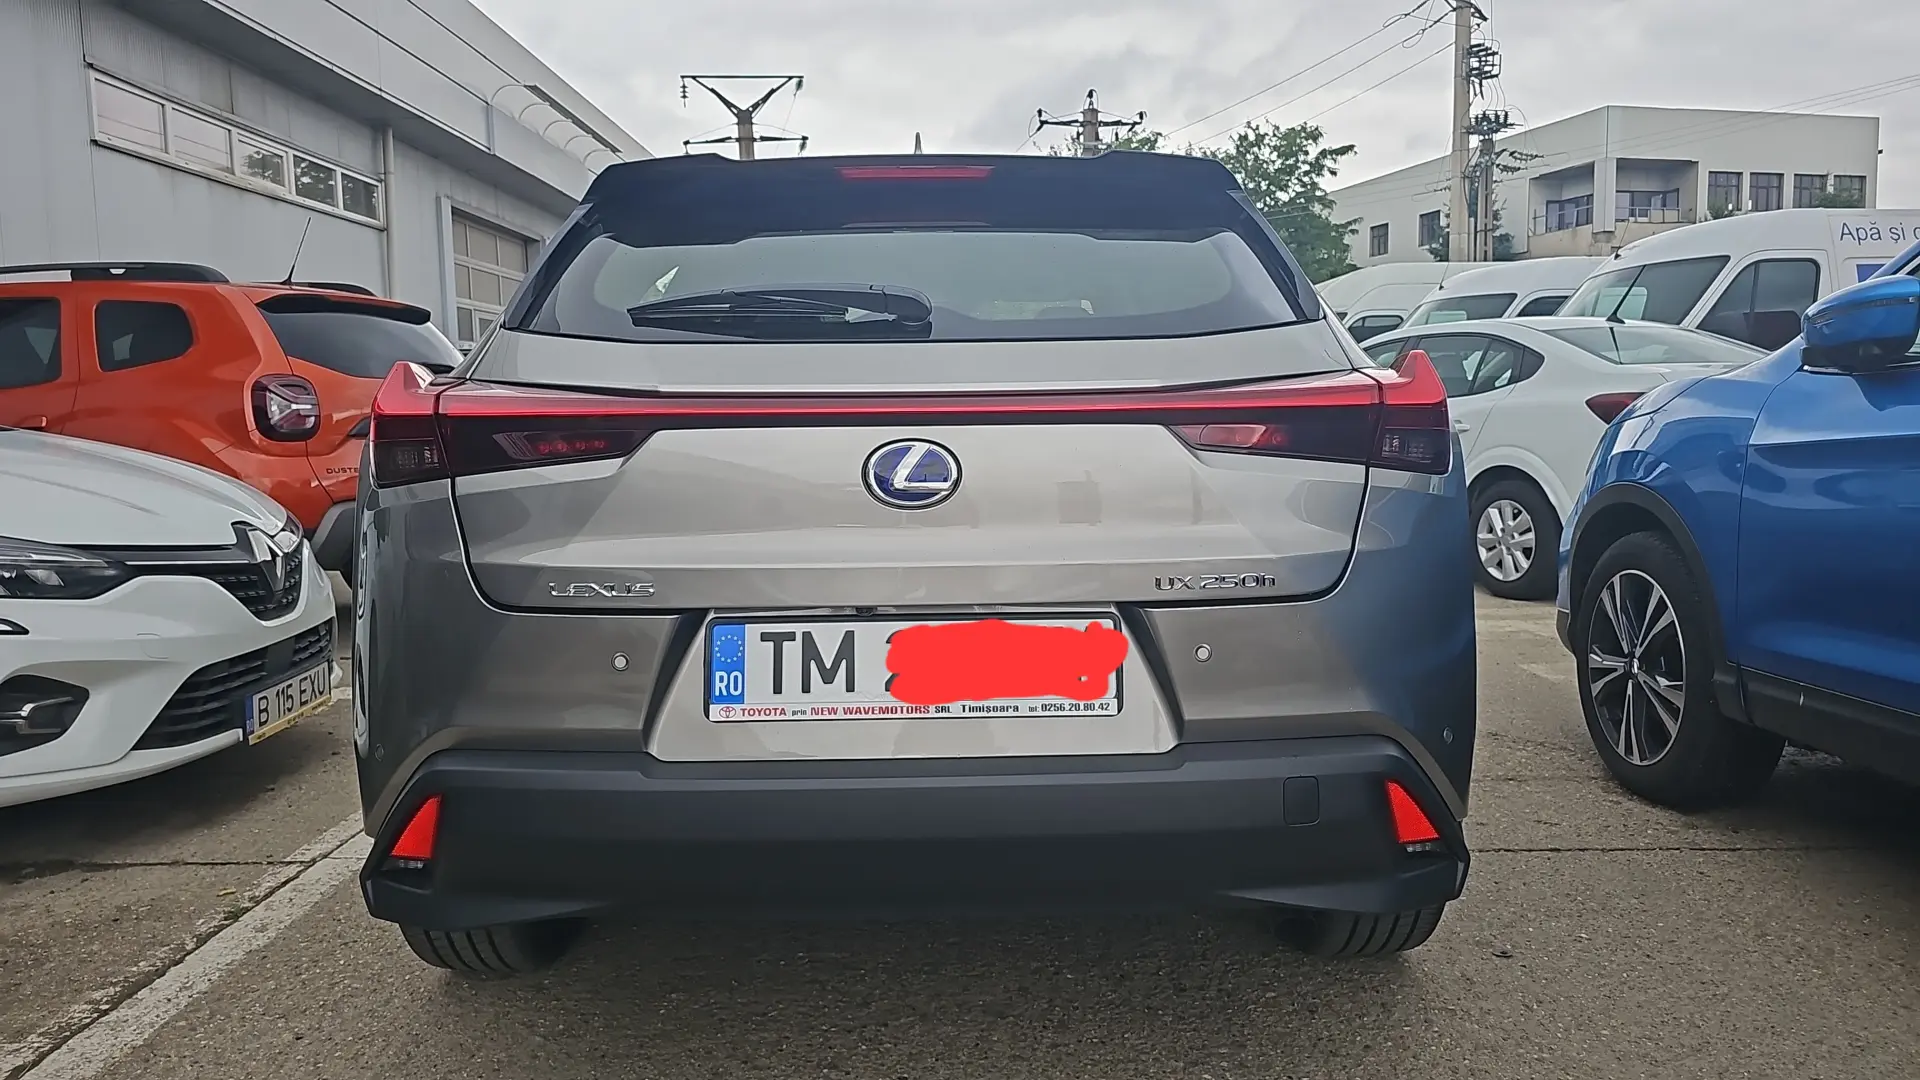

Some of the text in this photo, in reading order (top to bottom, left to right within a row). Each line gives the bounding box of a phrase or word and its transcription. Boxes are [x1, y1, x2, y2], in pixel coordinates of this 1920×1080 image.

[1840, 221, 1882, 246] Apă
[548, 582, 655, 597] LEXUS
[1154, 572, 1276, 590] UX 250h
[760, 630, 855, 694] TM
[715, 671, 743, 696] RO
[258, 667, 326, 727] B 115 EXU
[740, 707, 787, 717] TOYOTA
[791, 709, 808, 717] prin
[810, 706, 839, 716] NEW
[842, 705, 930, 715] WAVEMOTORS
[934, 705, 952, 714] SRL
[1041, 702, 1111, 713] 0256.20.80.42
